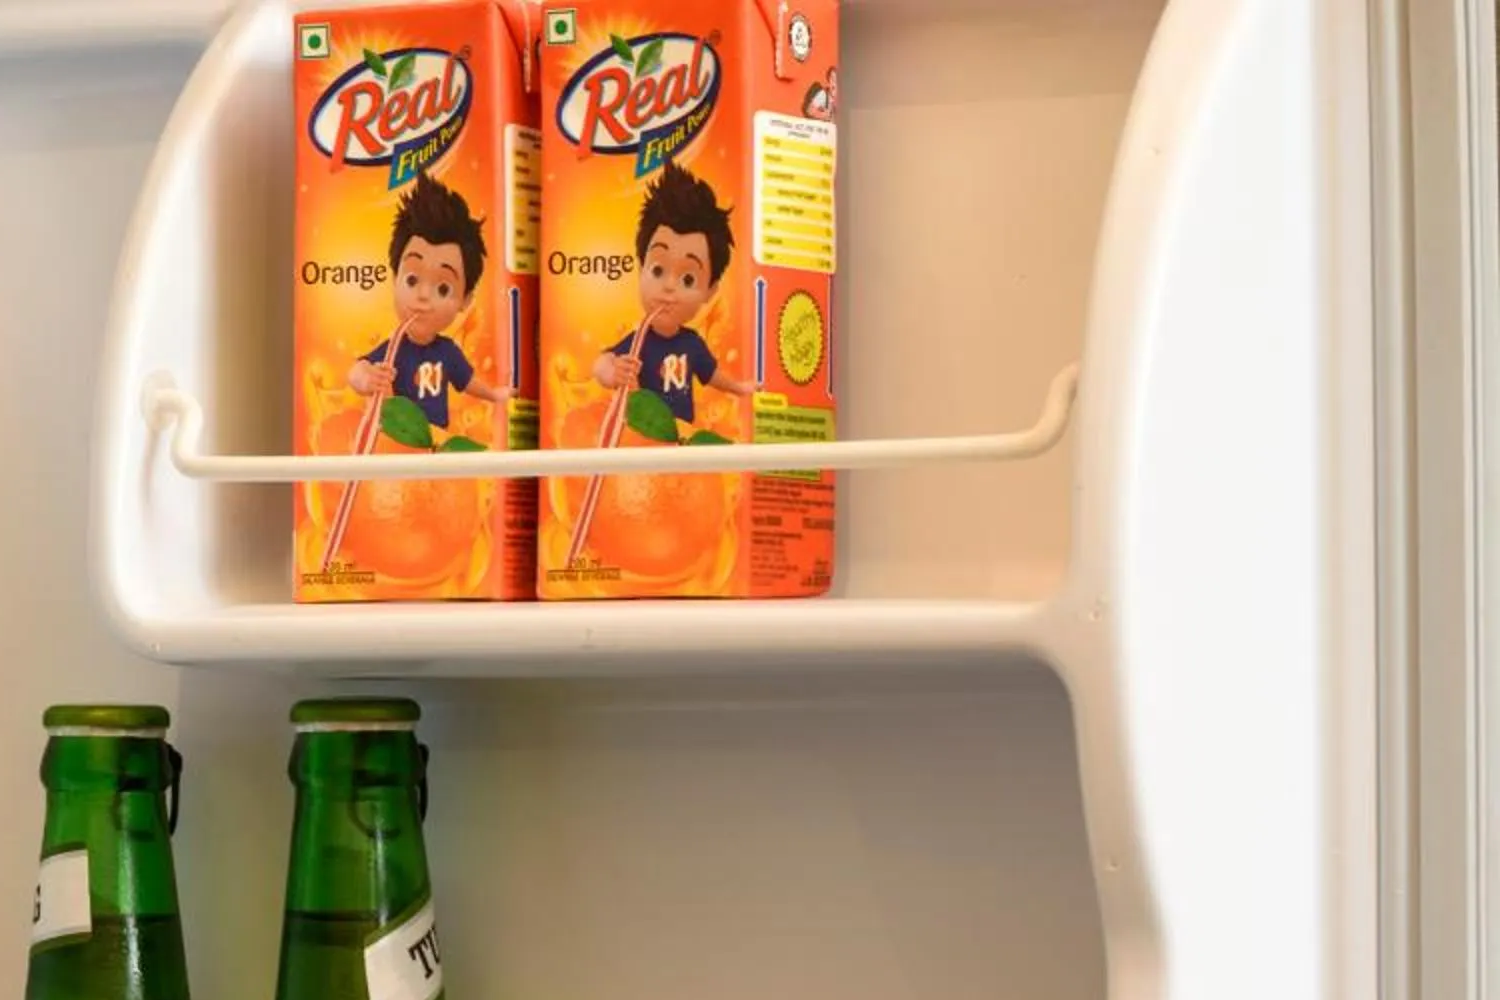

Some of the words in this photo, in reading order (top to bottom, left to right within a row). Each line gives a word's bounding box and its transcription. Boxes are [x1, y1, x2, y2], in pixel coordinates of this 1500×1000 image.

[329, 58, 462, 175] Real
[578, 39, 710, 163] Real
[396, 138, 438, 180] Fruit
[301, 261, 388, 290] Orange
[548, 250, 634, 277] Orange
